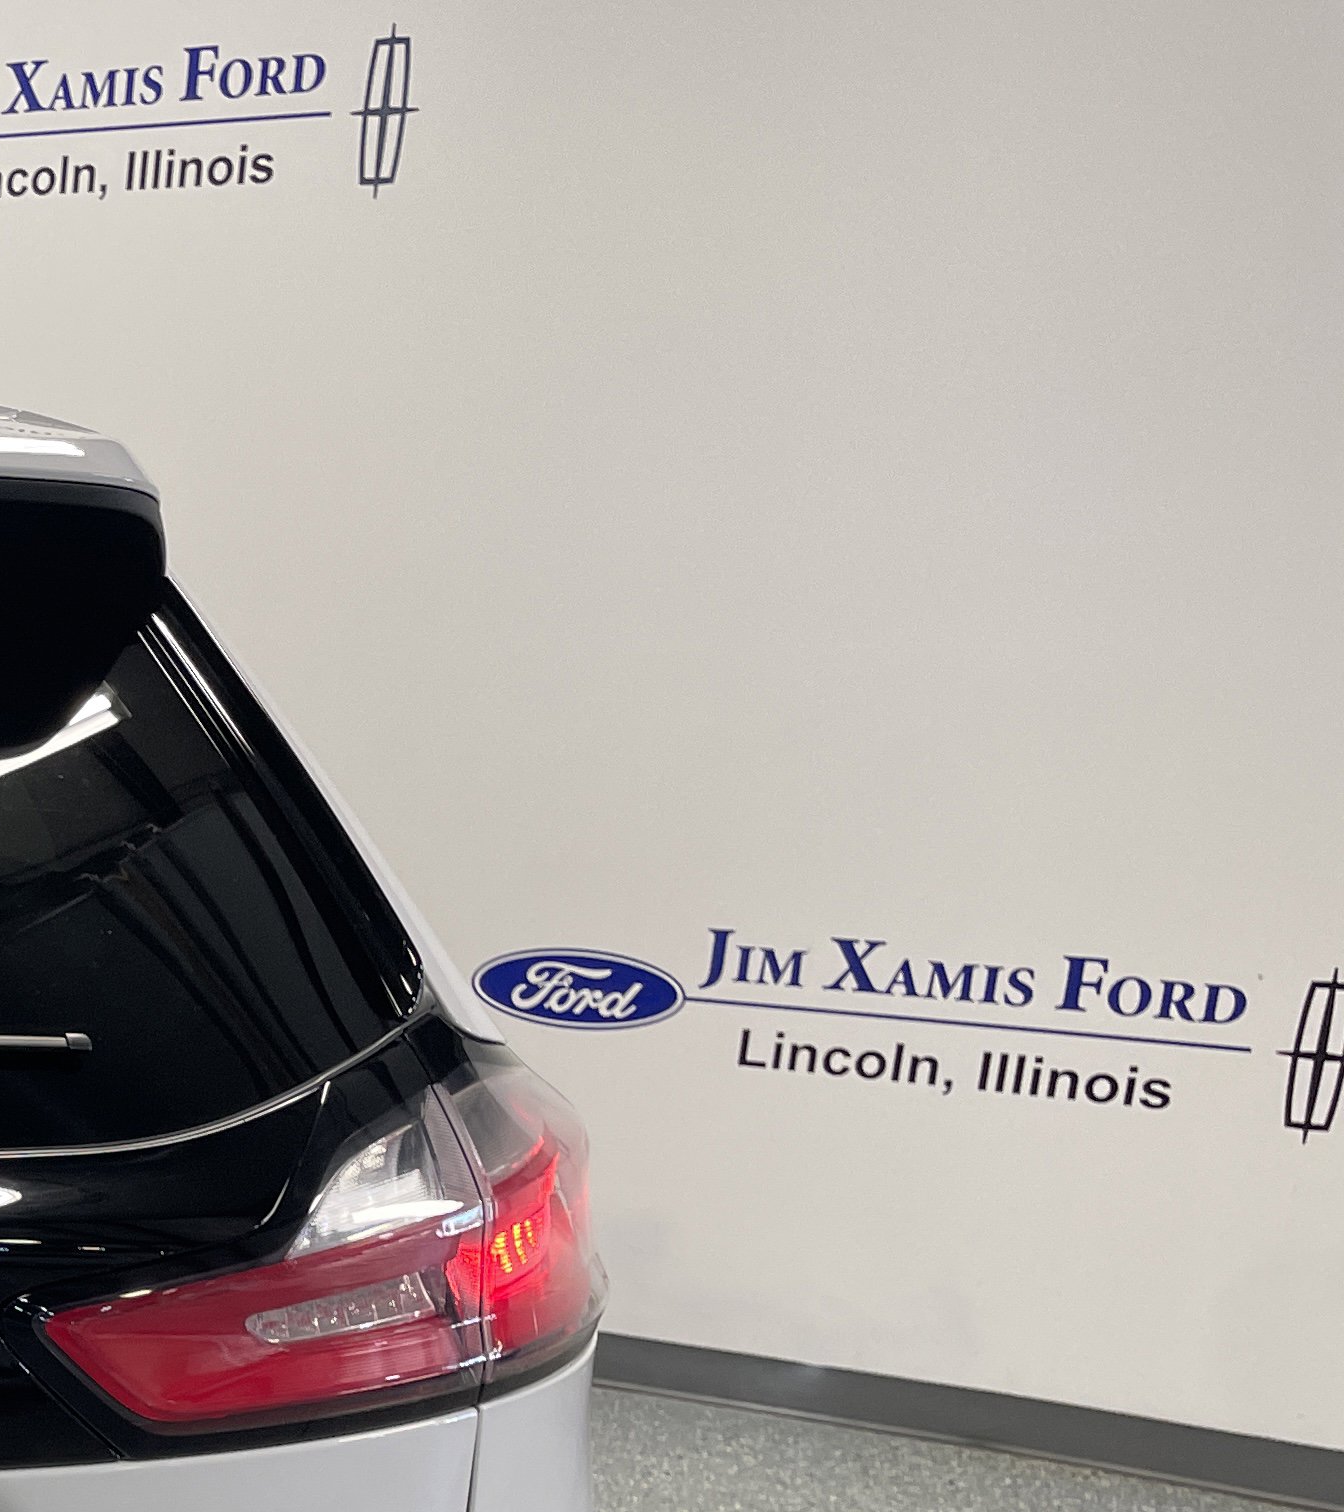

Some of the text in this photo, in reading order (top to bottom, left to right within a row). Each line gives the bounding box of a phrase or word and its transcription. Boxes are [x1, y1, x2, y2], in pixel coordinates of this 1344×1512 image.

[2, 60, 165, 116] XAMIS
[179, 45, 326, 102] FORD
[125, 144, 275, 192] Illinois
[698, 927, 1247, 1027] JIM XAMIS FORD
[736, 1029, 1173, 1111] Lincoln, Illinois
